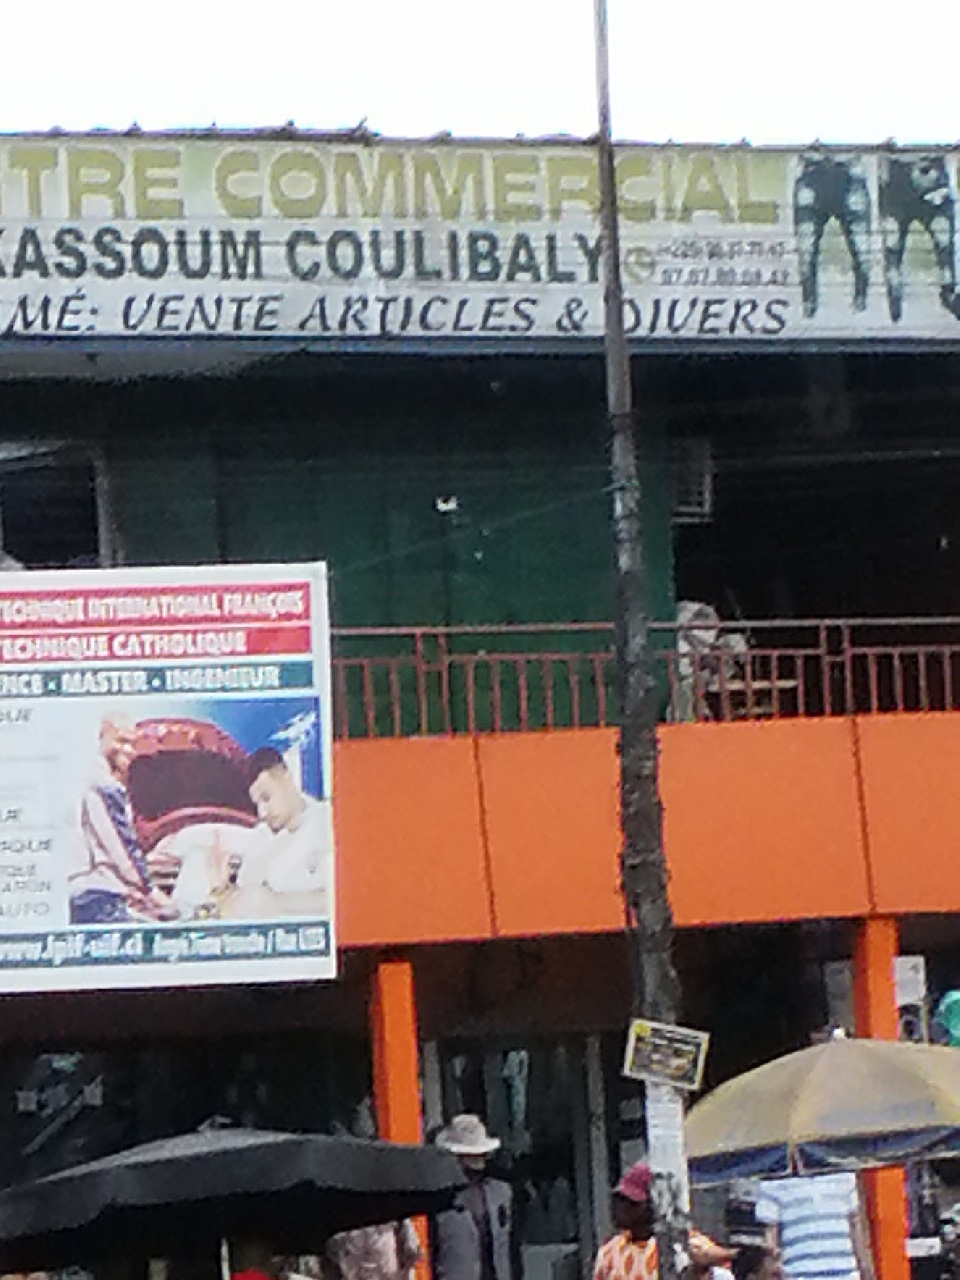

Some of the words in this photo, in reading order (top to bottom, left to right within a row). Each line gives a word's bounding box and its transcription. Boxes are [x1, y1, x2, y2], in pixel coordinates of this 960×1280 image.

[214, 147, 780, 224] COMMERCIAL
[285, 230, 604, 284] COULIBALY
[298, 294, 538, 336] ARTICLES
[555, 297, 589, 333] &
[88, 592, 221, 621] INTERNATIONAL
[111, 630, 247, 657] CATHOLIQUE
[61, 670, 150, 694] MASTER
